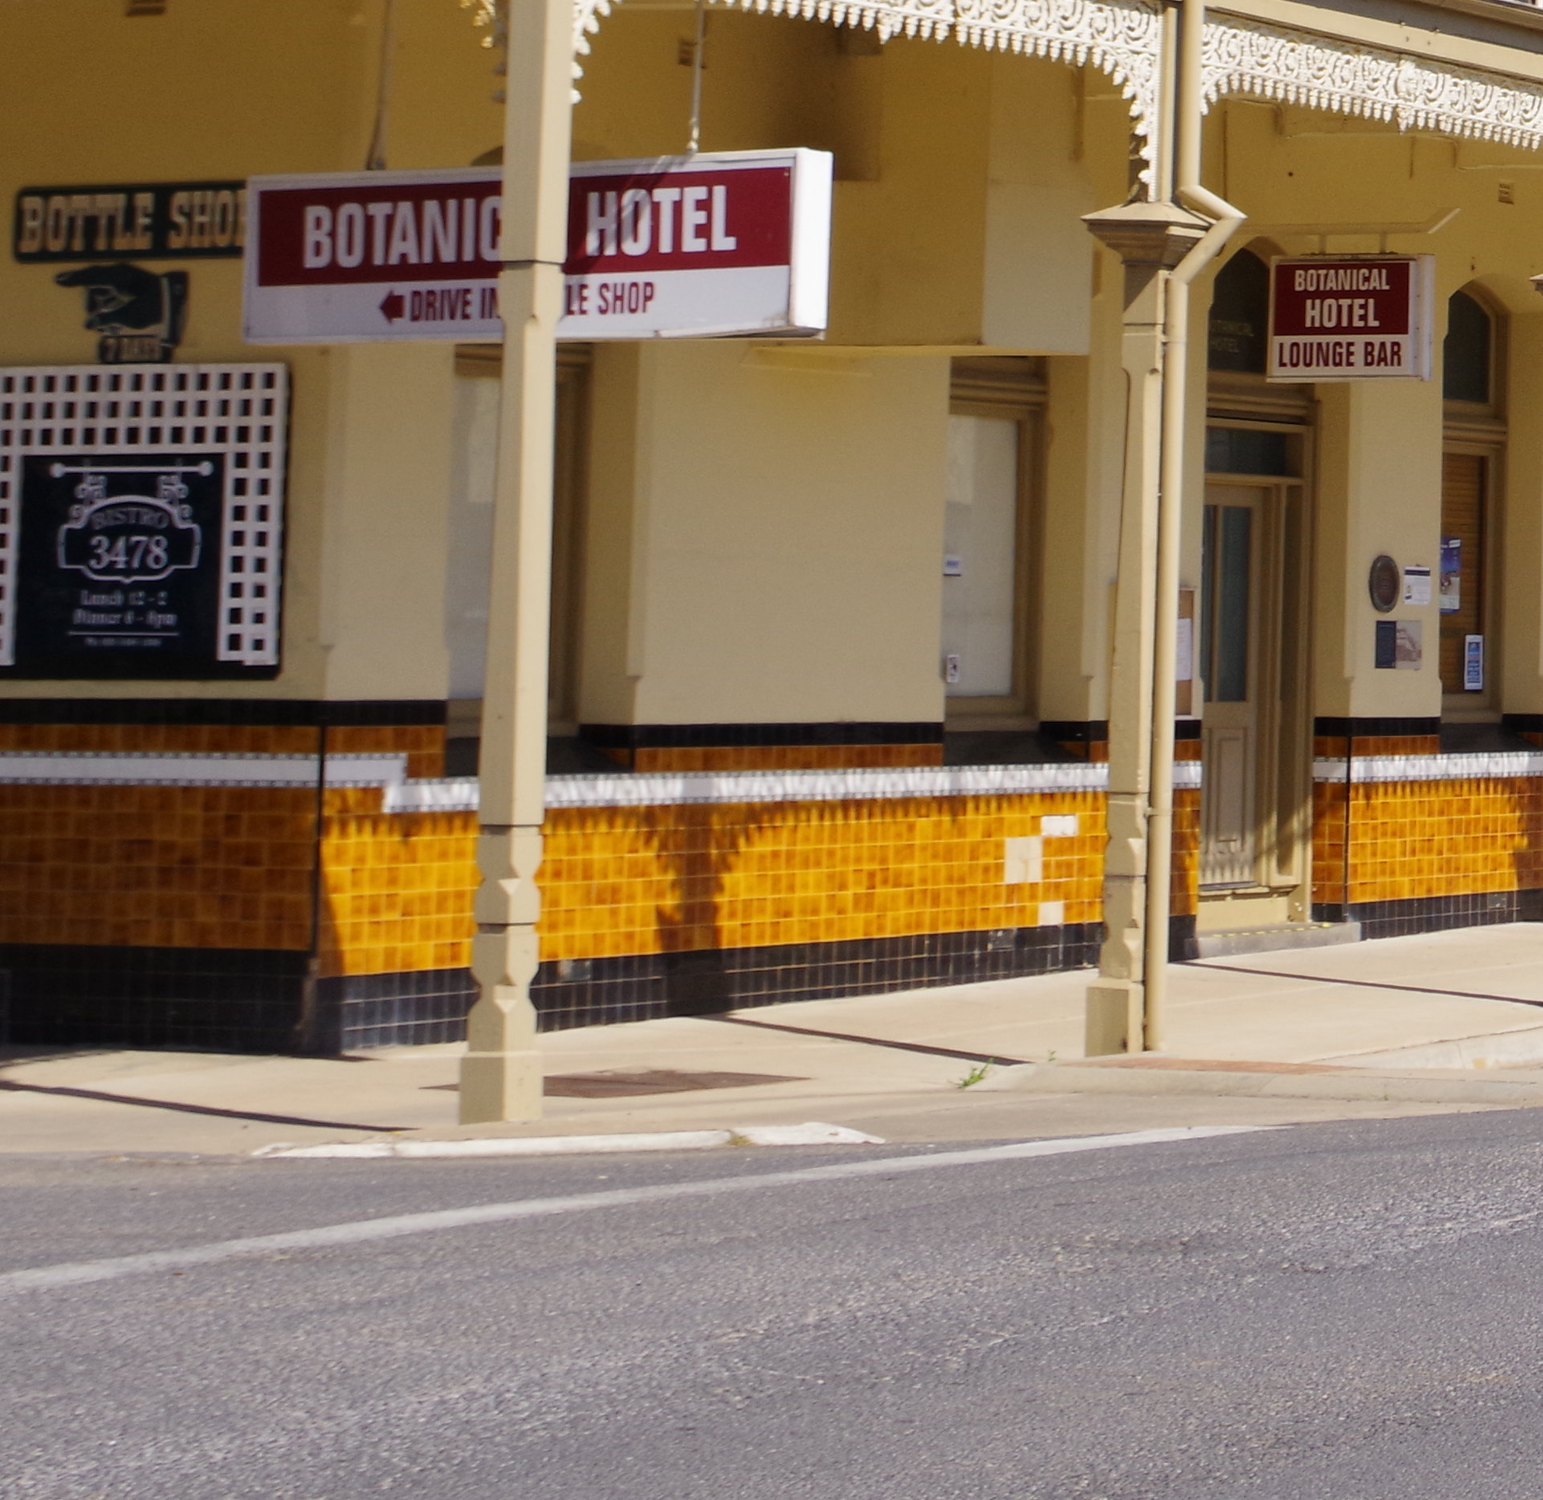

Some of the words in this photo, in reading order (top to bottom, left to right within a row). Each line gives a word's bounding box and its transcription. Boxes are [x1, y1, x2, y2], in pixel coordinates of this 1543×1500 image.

[19, 192, 155, 253] BOTTLE
[303, 195, 503, 268] BOTANIC
[586, 185, 737, 258] HOTEL
[1294, 268, 1391, 292] BOTANICAL
[410, 288, 472, 322] DRIVE
[598, 281, 655, 315] SHOP
[1304, 298, 1380, 328] HOTEL
[1277, 341, 1355, 368] LOUNGE
[1363, 341, 1402, 367] BAR
[89, 507, 170, 530] BISTRO
[88, 535, 169, 570] 3478
